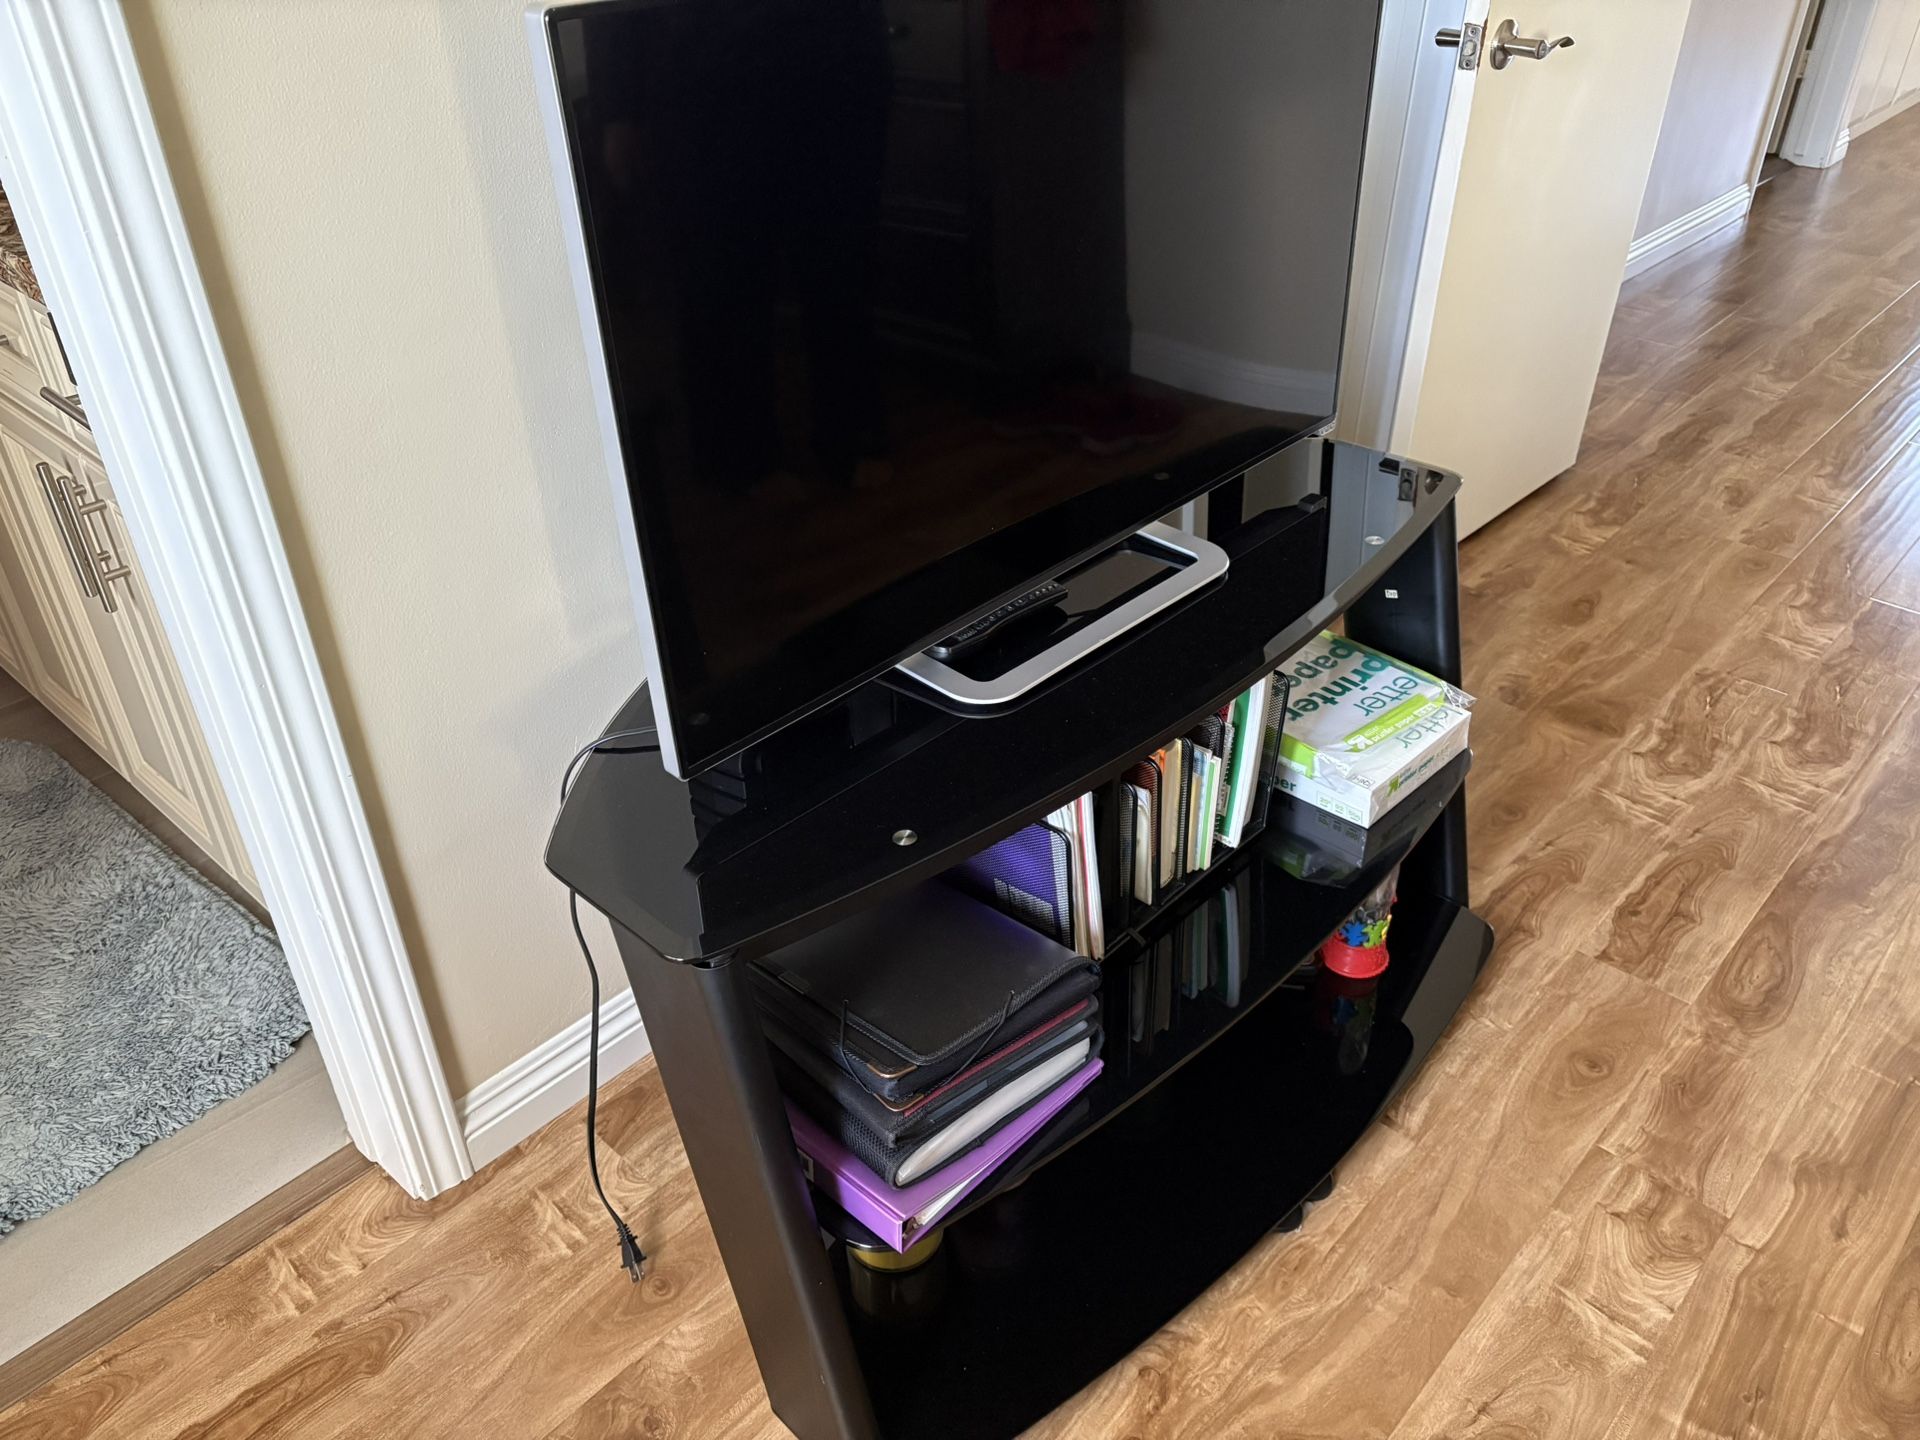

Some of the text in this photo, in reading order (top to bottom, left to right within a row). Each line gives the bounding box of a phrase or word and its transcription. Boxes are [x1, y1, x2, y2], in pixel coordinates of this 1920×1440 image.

[1286, 638, 1357, 688] pape
[1286, 653, 1393, 721] printer
[1353, 676, 1418, 717] etter
[1395, 707, 1463, 749] letter
[1273, 775, 1297, 792] per
